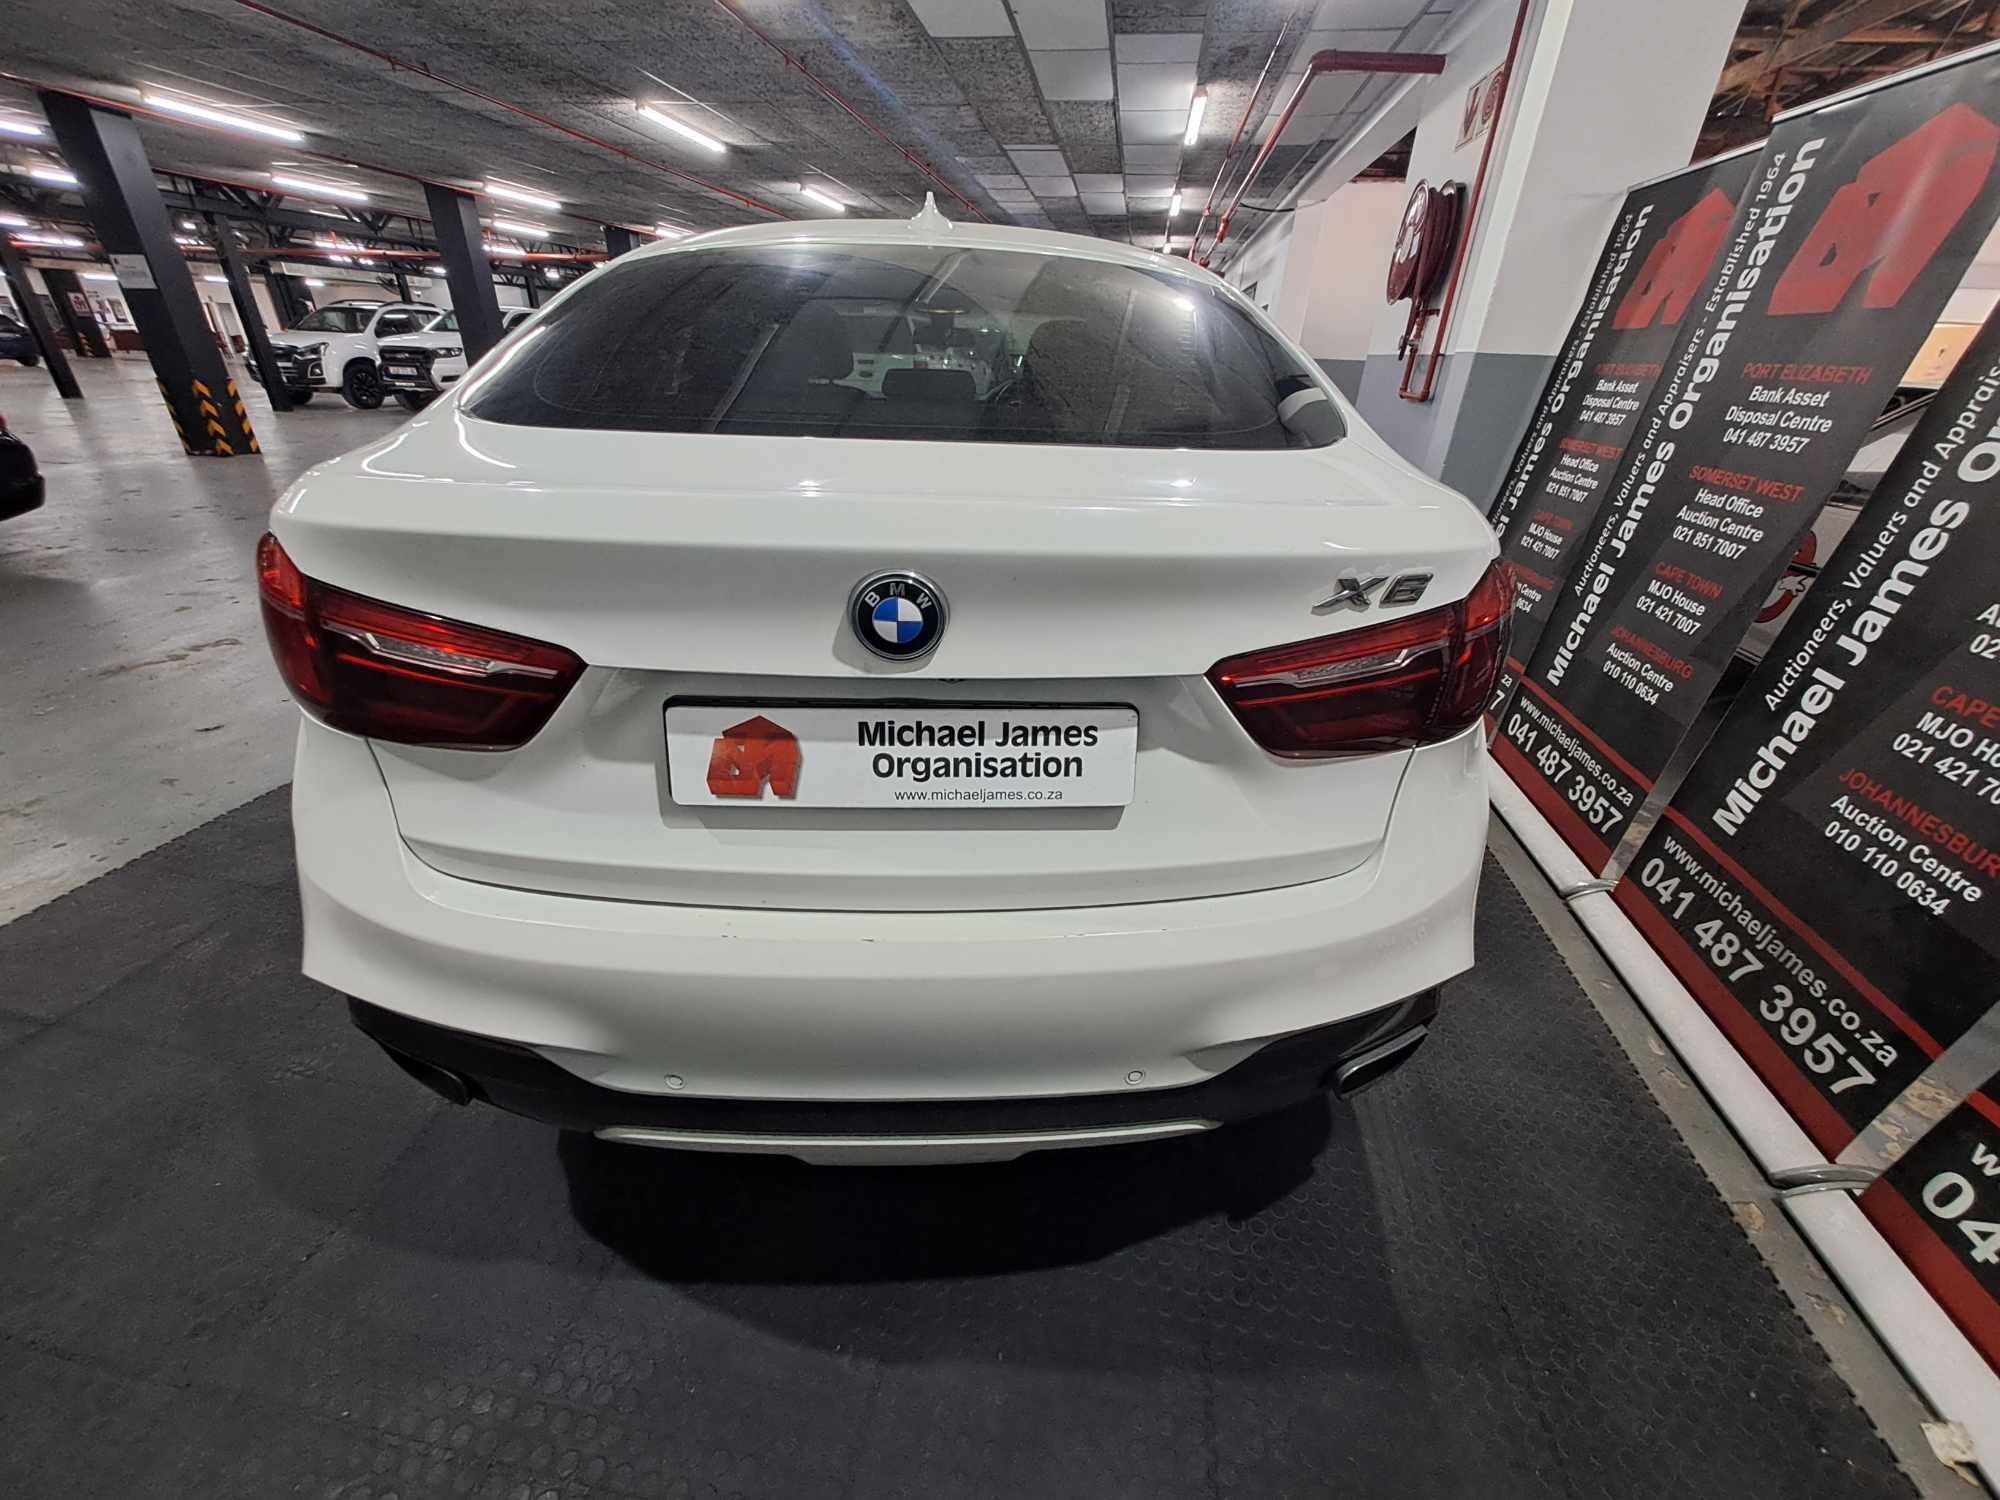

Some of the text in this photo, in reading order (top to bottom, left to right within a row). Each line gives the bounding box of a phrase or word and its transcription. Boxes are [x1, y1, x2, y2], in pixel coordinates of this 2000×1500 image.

[1508, 422, 1553, 510] James
[1550, 204, 1655, 414] Organisation
[1574, 512, 1620, 597] Auctioneers,
[1613, 452, 1646, 507] Valuers
[1643, 417, 1662, 449] and
[1658, 326, 1704, 416] Appraisers
[1705, 207, 1761, 313] Established
[1756, 152, 1786, 203] 1964
[1546, 562, 1616, 687] Michael
[1610, 441, 1676, 558] James
[1668, 137, 1827, 430] Organisation
[1748, 385, 1831, 408] Bank Asset
[1724, 406, 1833, 432] Disposal Centre
[1723, 428, 1811, 455] 041 487 3957
[1689, 464, 1807, 502] SOMERSET WEST
[1694, 487, 1764, 519] Head Office
[1673, 525, 1747, 561] 021 851 7007
[1676, 504, 1764, 543] Auction Centre
[1764, 357, 2000, 713] Auctioneers, Valuers and Apprais
[1309, 573, 1434, 607] X6
[1655, 561, 1687, 584] CAPE
[864, 582, 932, 609] BMW
[1636, 595, 1701, 636] 021 421 7007
[1648, 579, 1706, 616] MJO House
[1602, 660, 1660, 706] 010 110 0634
[1606, 642, 1674, 692] Auction Centre
[1712, 667, 1846, 837] Michael
[1836, 500, 1970, 667] James
[857, 720, 1098, 747] Michael James
[1916, 711, 1974, 748] MJO
[872, 752, 1083, 782] Organisation
[1520, 696, 1634, 807] www.michaeljames.co.za
[1893, 734, 1935, 764] 021
[1934, 757, 1980, 787] 421
[1507, 713, 1624, 834] 041 487 3957
[894, 788, 1063, 803] www.michaeljames.co.za
[1824, 820, 1951, 916] 010 110 0634
[1830, 795, 1982, 903] Auction Centre
[1664, 835, 1899, 1068] www.michaeljames.co.za
[1641, 858, 1878, 1094] 041 487 3957
